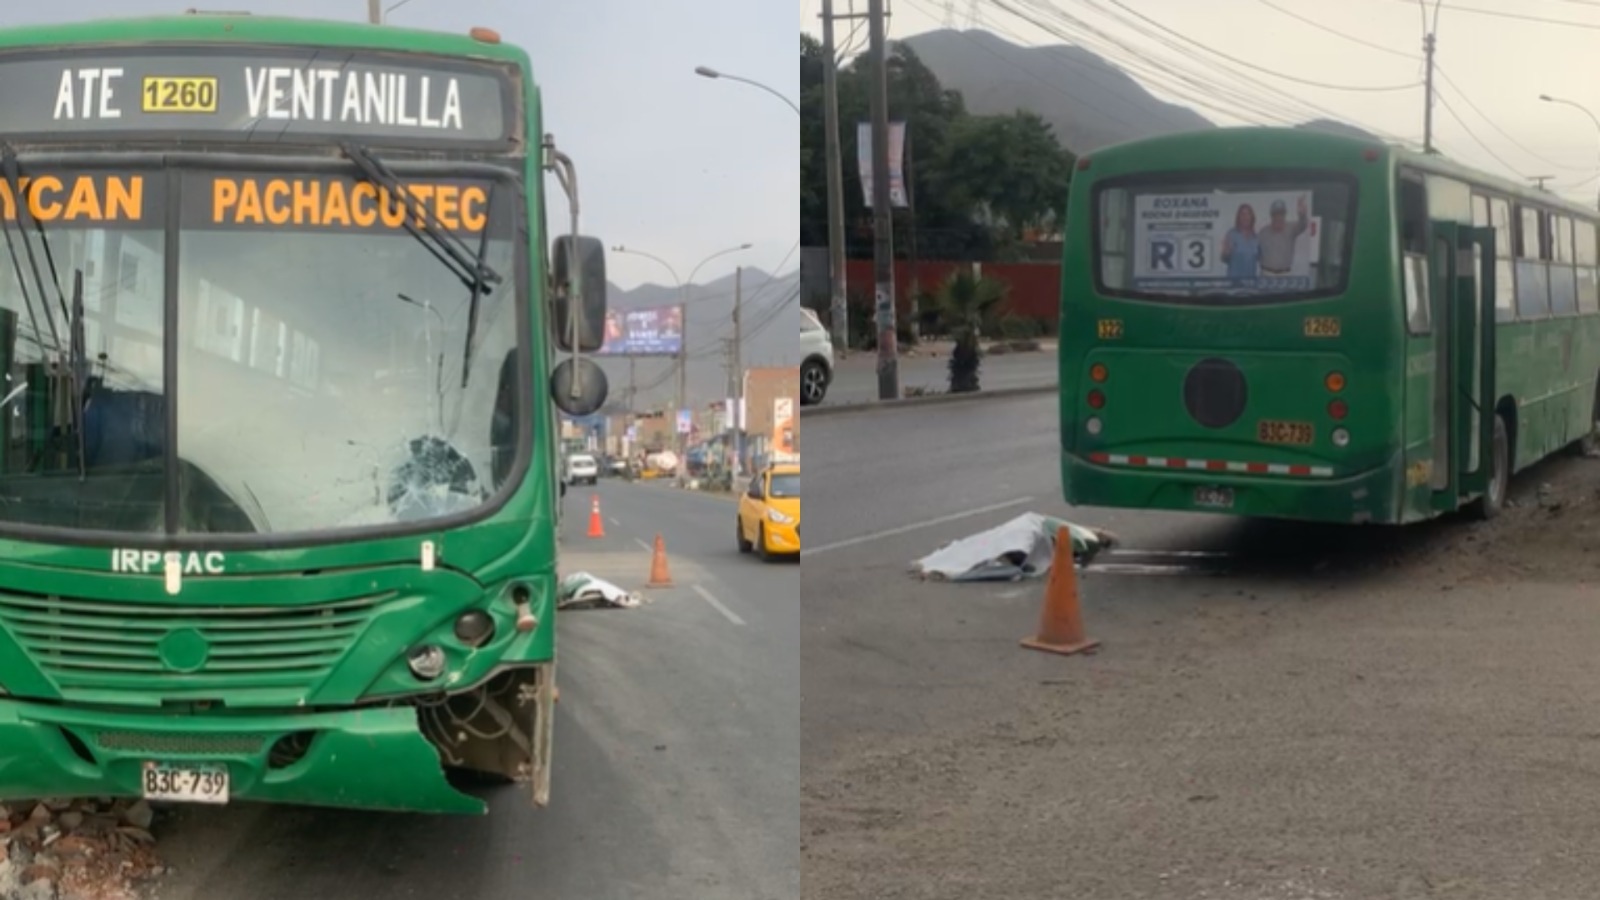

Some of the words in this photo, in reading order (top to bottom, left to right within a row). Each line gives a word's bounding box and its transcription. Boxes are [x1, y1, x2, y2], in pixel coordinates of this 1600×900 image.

[53, 67, 124, 119] ATE
[145, 80, 213, 108] 1260
[245, 66, 463, 129] VENTANILLA
[213, 178, 487, 232] PACHACUTEC
[1151, 241, 1175, 270] R
[1188, 241, 1205, 268] 3
[145, 769, 225, 796] B3C-739
